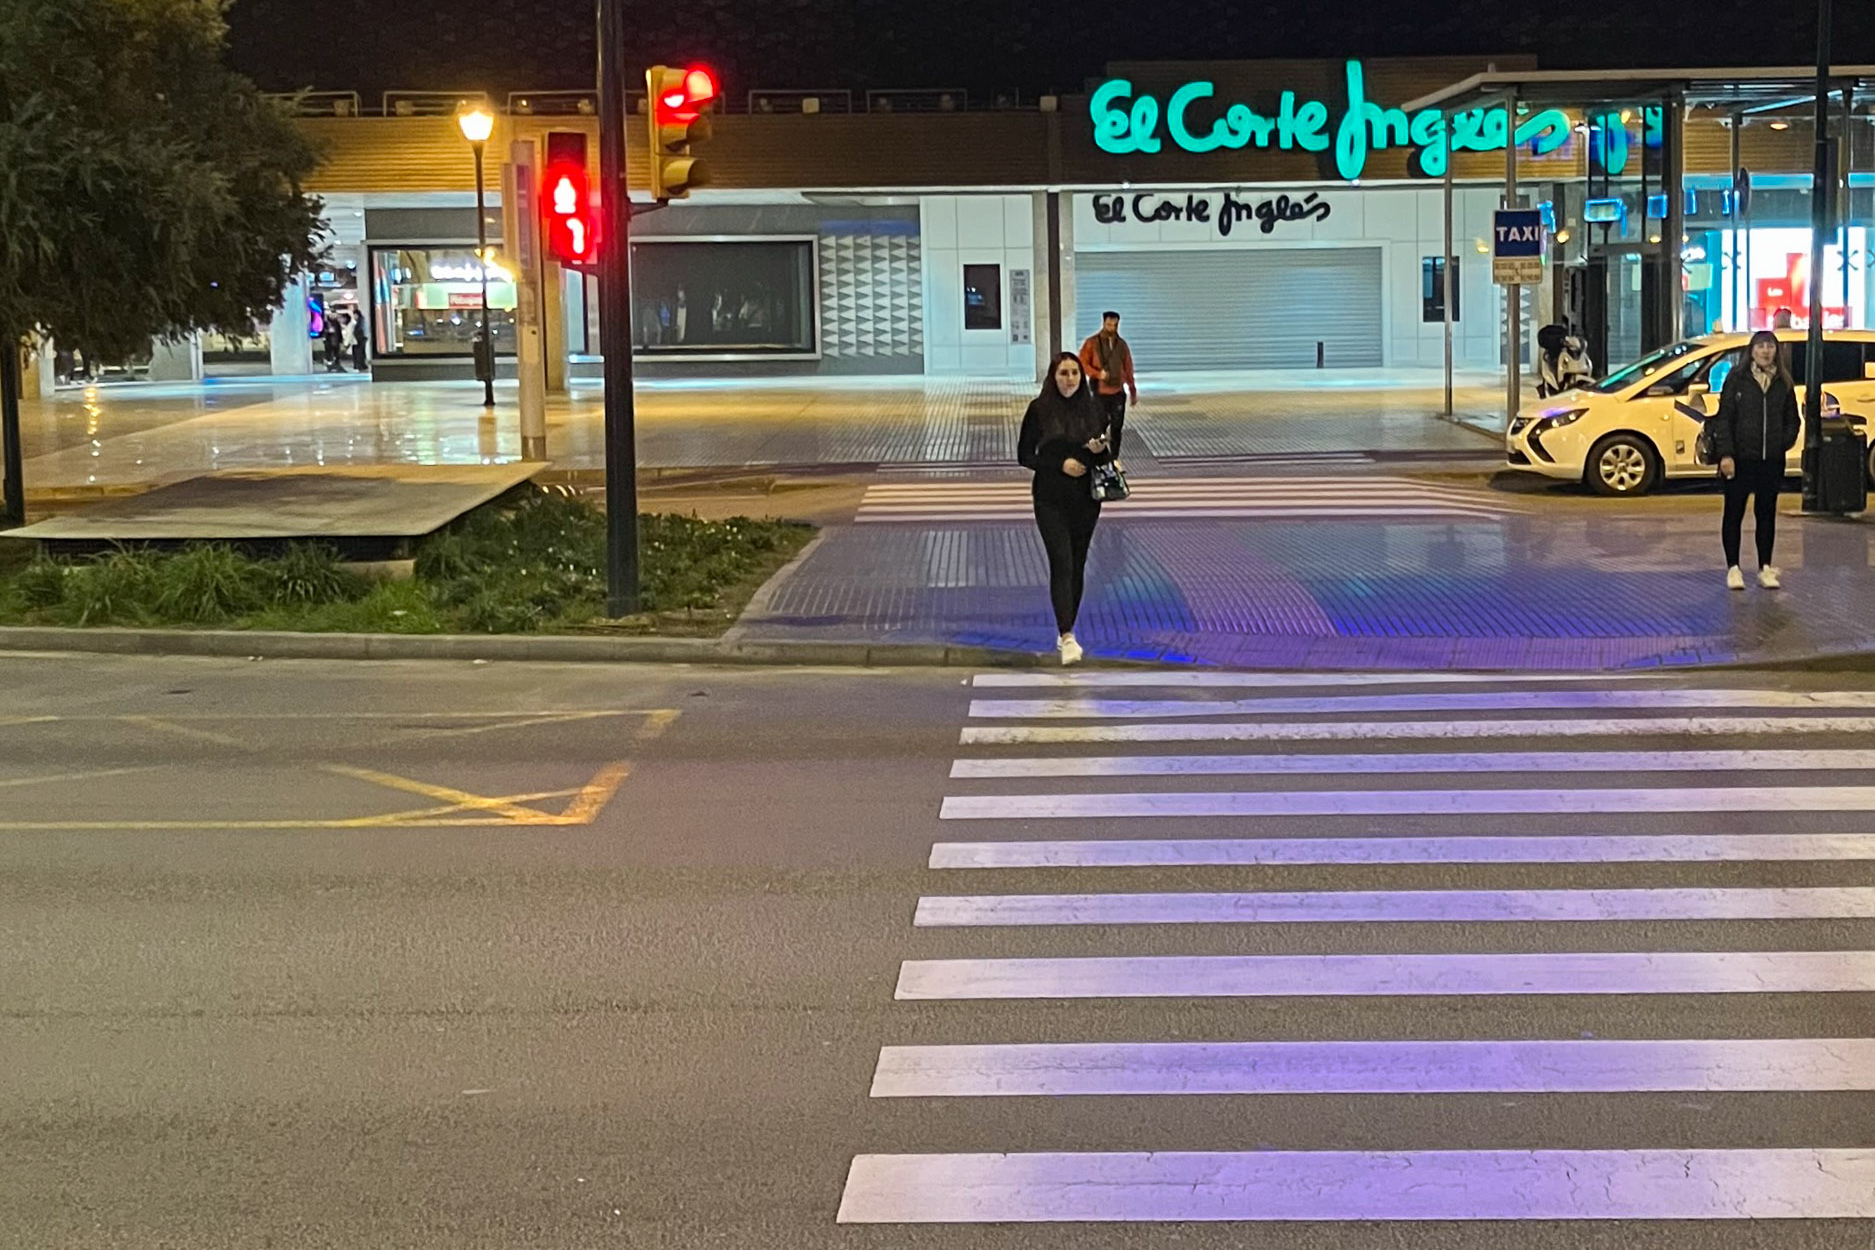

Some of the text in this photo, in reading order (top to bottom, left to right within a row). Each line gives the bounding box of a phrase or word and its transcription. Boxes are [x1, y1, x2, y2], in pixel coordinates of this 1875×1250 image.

[1090, 79, 1161, 154] El
[1167, 81, 1330, 153] Corte
[1092, 192, 1331, 236] El Corte Inglés
[1495, 226, 1540, 242] TAXI
